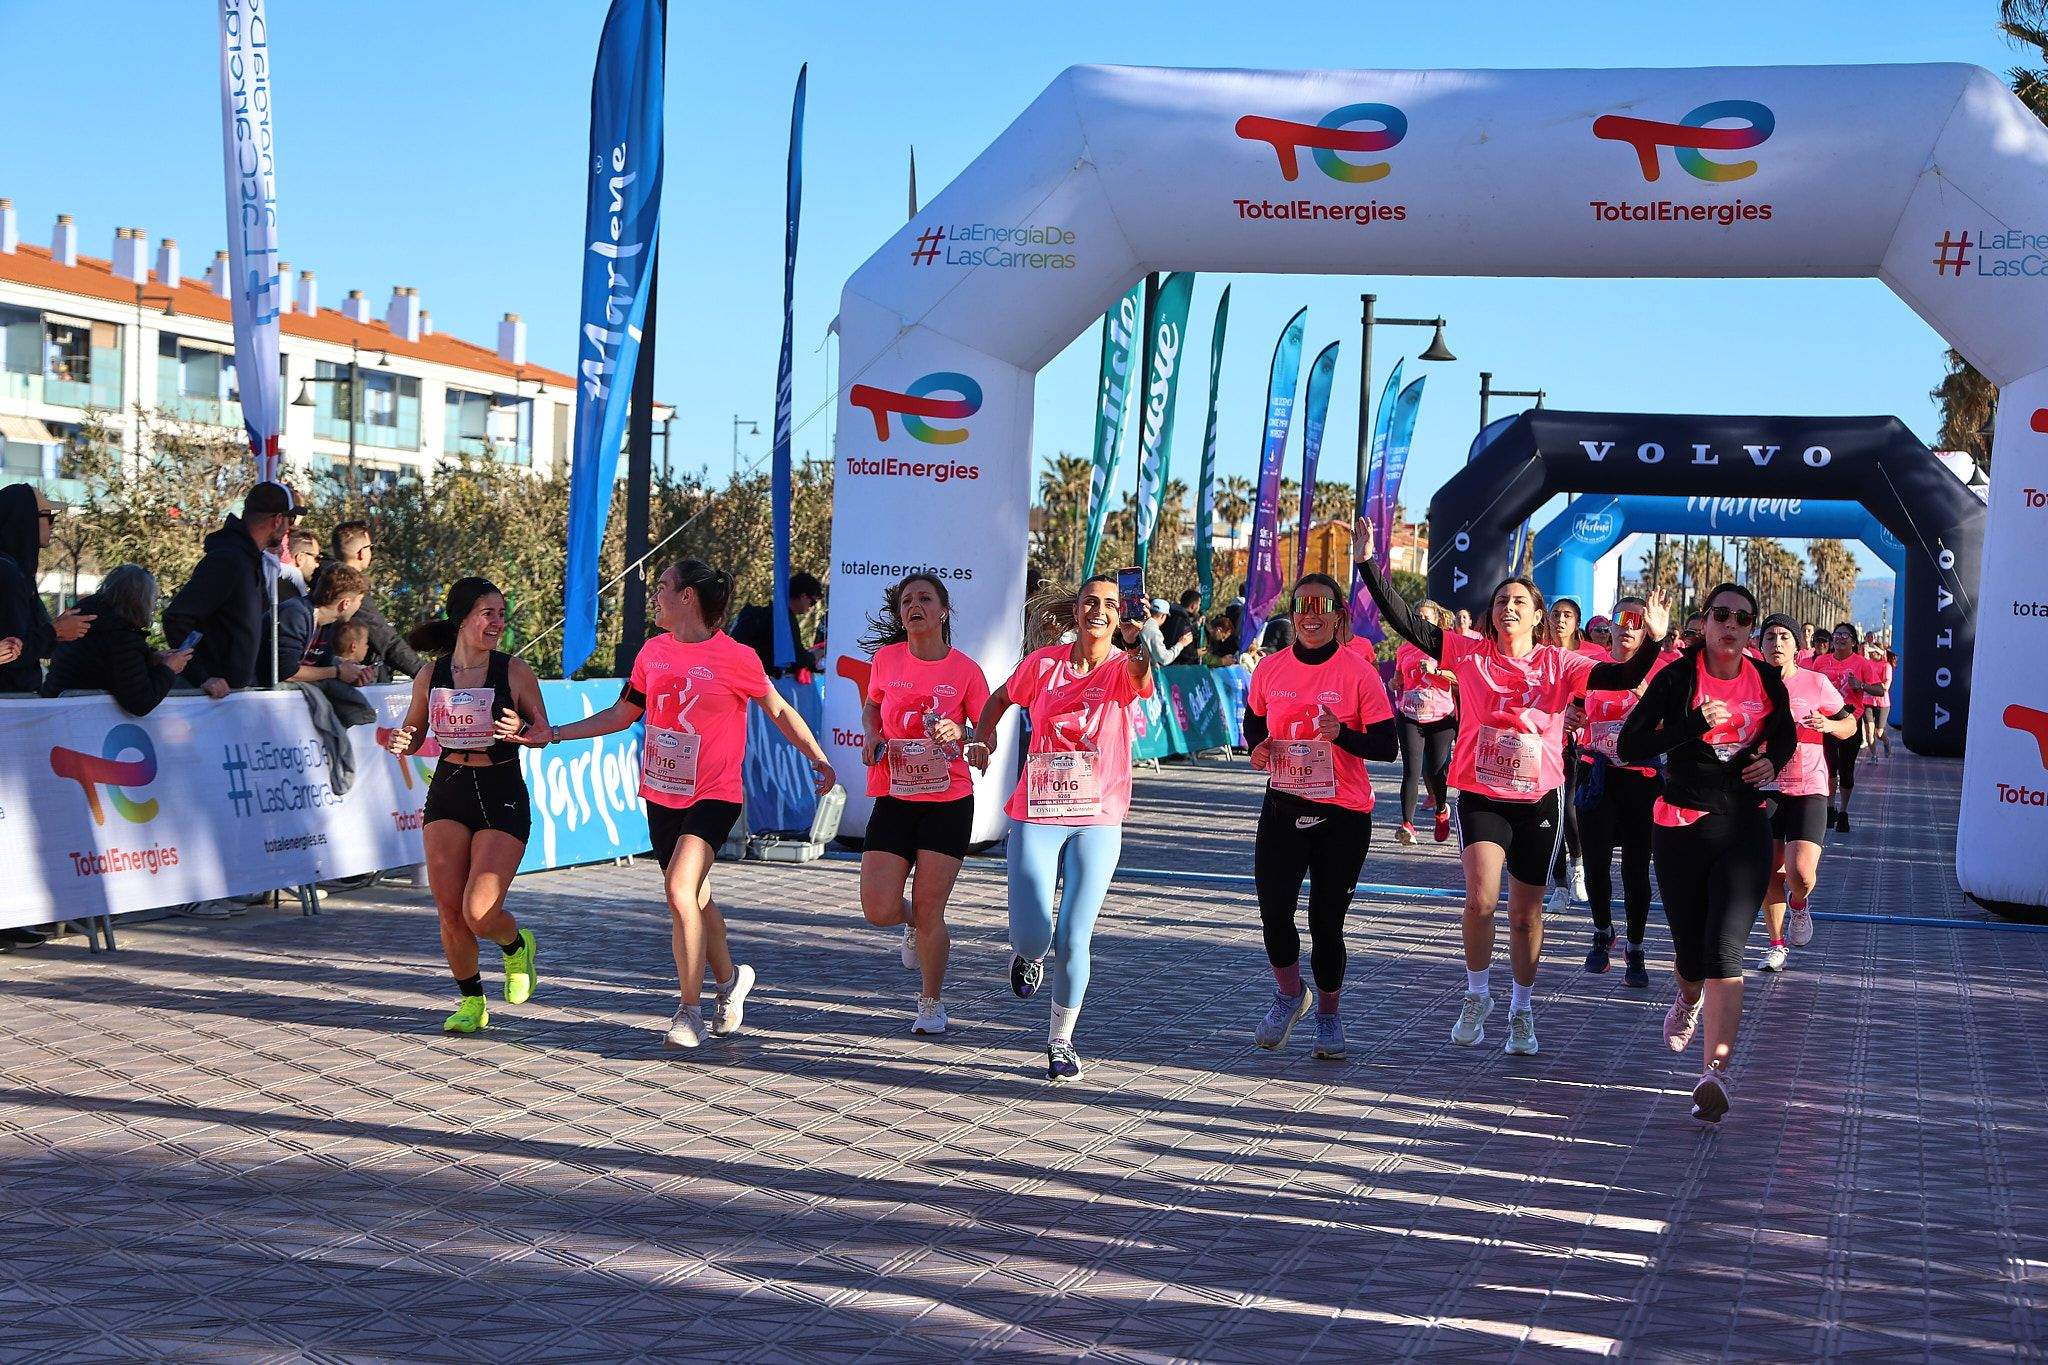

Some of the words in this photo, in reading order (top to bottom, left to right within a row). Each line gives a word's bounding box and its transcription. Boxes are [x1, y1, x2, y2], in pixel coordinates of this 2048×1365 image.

[1233, 200, 1407, 225] TotalEnergies
[1590, 199, 1773, 225] TotalEnergies
[949, 223, 1076, 246] LaEnergíaDe
[946, 246, 1076, 269] LasCarreras
[1579, 440, 1832, 467] VOLVO
[846, 457, 979, 482] TotalEnergies
[1934, 549, 1955, 730] VOLVO
[449, 715, 474, 725] 016
[657, 756, 676, 770] 016
[906, 764, 930, 774] 016
[1290, 765, 1313, 776] 016
[1497, 755, 1521, 769] 016
[1053, 780, 1079, 791] 016
[68, 842, 179, 876] TotalEnergies
